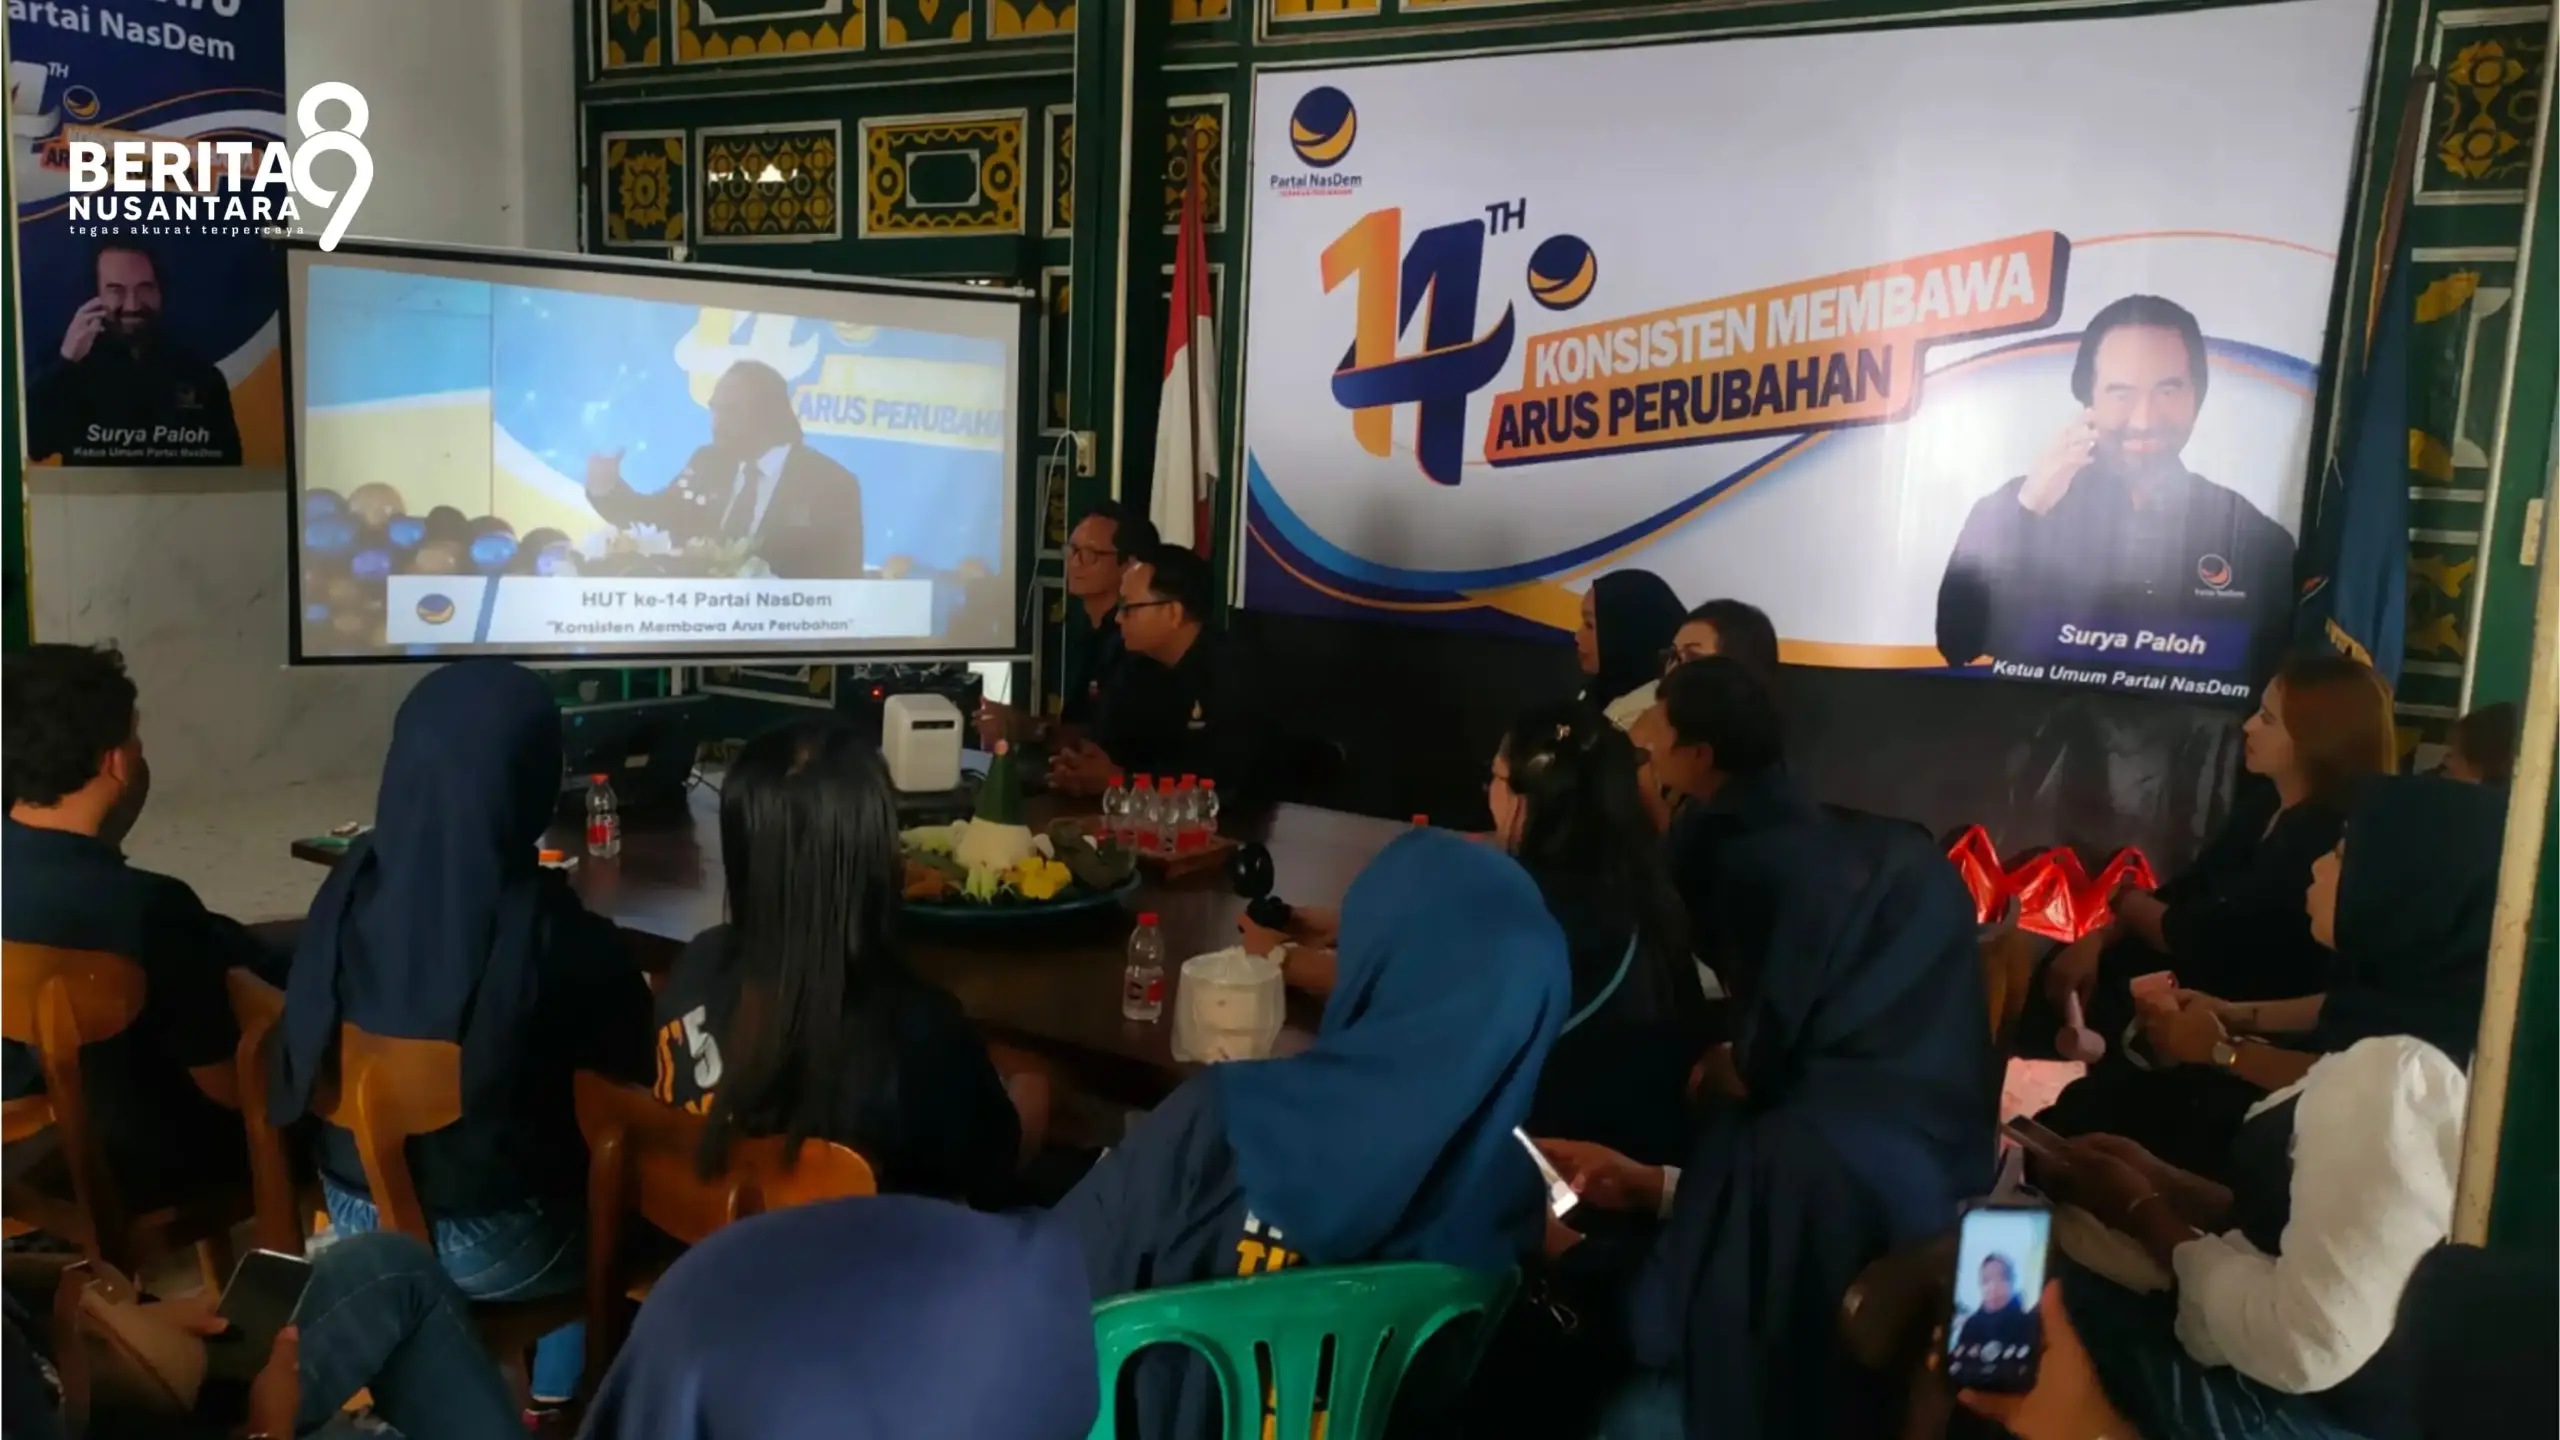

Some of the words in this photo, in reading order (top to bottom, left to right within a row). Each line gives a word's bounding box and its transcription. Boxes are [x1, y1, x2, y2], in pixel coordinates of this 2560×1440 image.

[8, 0, 91, 33] artai
[99, 9, 236, 61] NasDem
[47, 61, 70, 79] TH
[1270, 174, 1307, 189] Partai
[1309, 172, 1363, 188] NasDem
[1535, 303, 1756, 389] KONSISTEN
[1767, 250, 2035, 350] MEMBAWA
[1320, 206, 1515, 486] 14
[1485, 197, 1527, 236] TH
[797, 391, 867, 426] ARUS
[1495, 390, 1600, 451] ARUS
[1608, 344, 1894, 437] PERUBAHAN
[86, 423, 147, 446] Surya
[153, 425, 210, 444] Paloh
[581, 591, 627, 607] HUT
[634, 591, 688, 607] ke-14
[694, 591, 750, 607] Partai
[756, 591, 832, 607] NasDem
[639, 619, 727, 633] Membawa
[732, 619, 764, 632] Arus
[2058, 624, 2128, 651] Surya
[2134, 630, 2207, 655] Paloh
[1992, 659, 2044, 679] Ketua
[2049, 664, 2107, 685] Umum
[2111, 670, 2167, 691] Partai
[2169, 676, 2250, 699] NasDem
